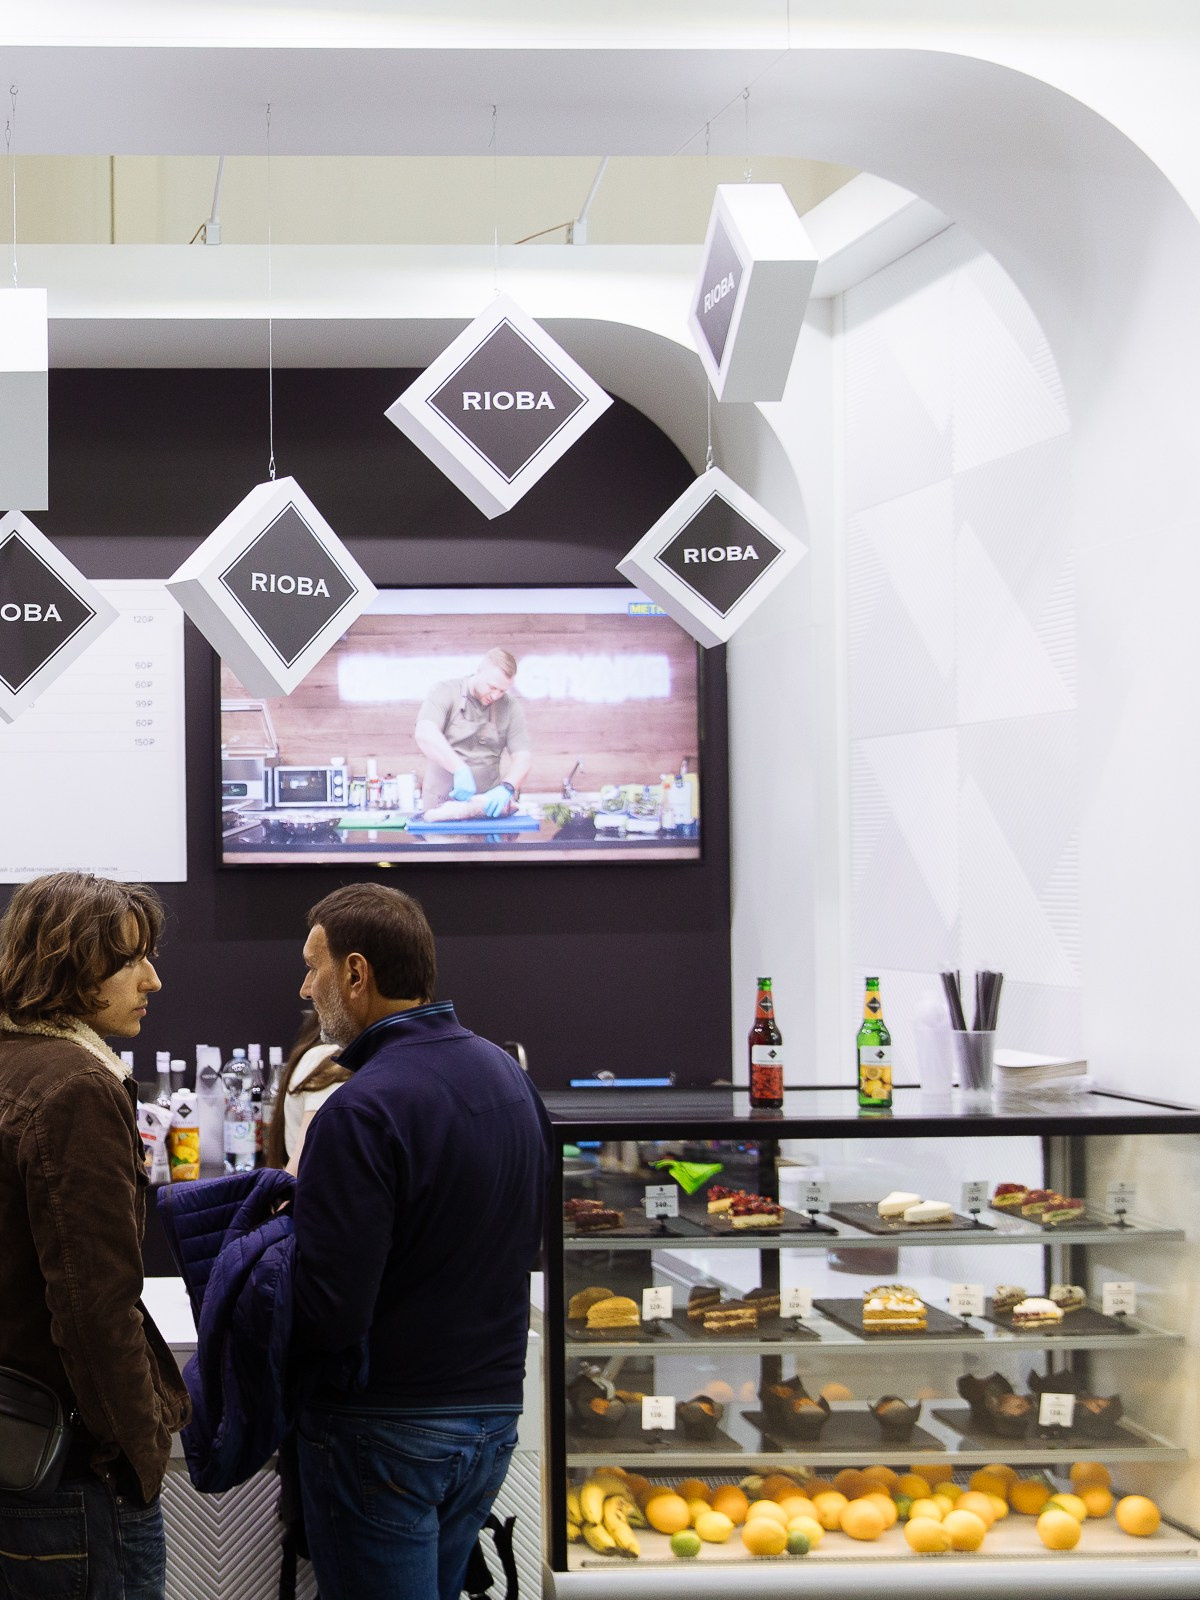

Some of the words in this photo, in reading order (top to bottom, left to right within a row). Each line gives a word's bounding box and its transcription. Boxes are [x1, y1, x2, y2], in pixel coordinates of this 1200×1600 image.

[703, 271, 736, 314] RIOBA
[462, 391, 556, 410] RIOBA
[683, 544, 760, 564] RIOBA
[250, 572, 331, 598] RIOBA
